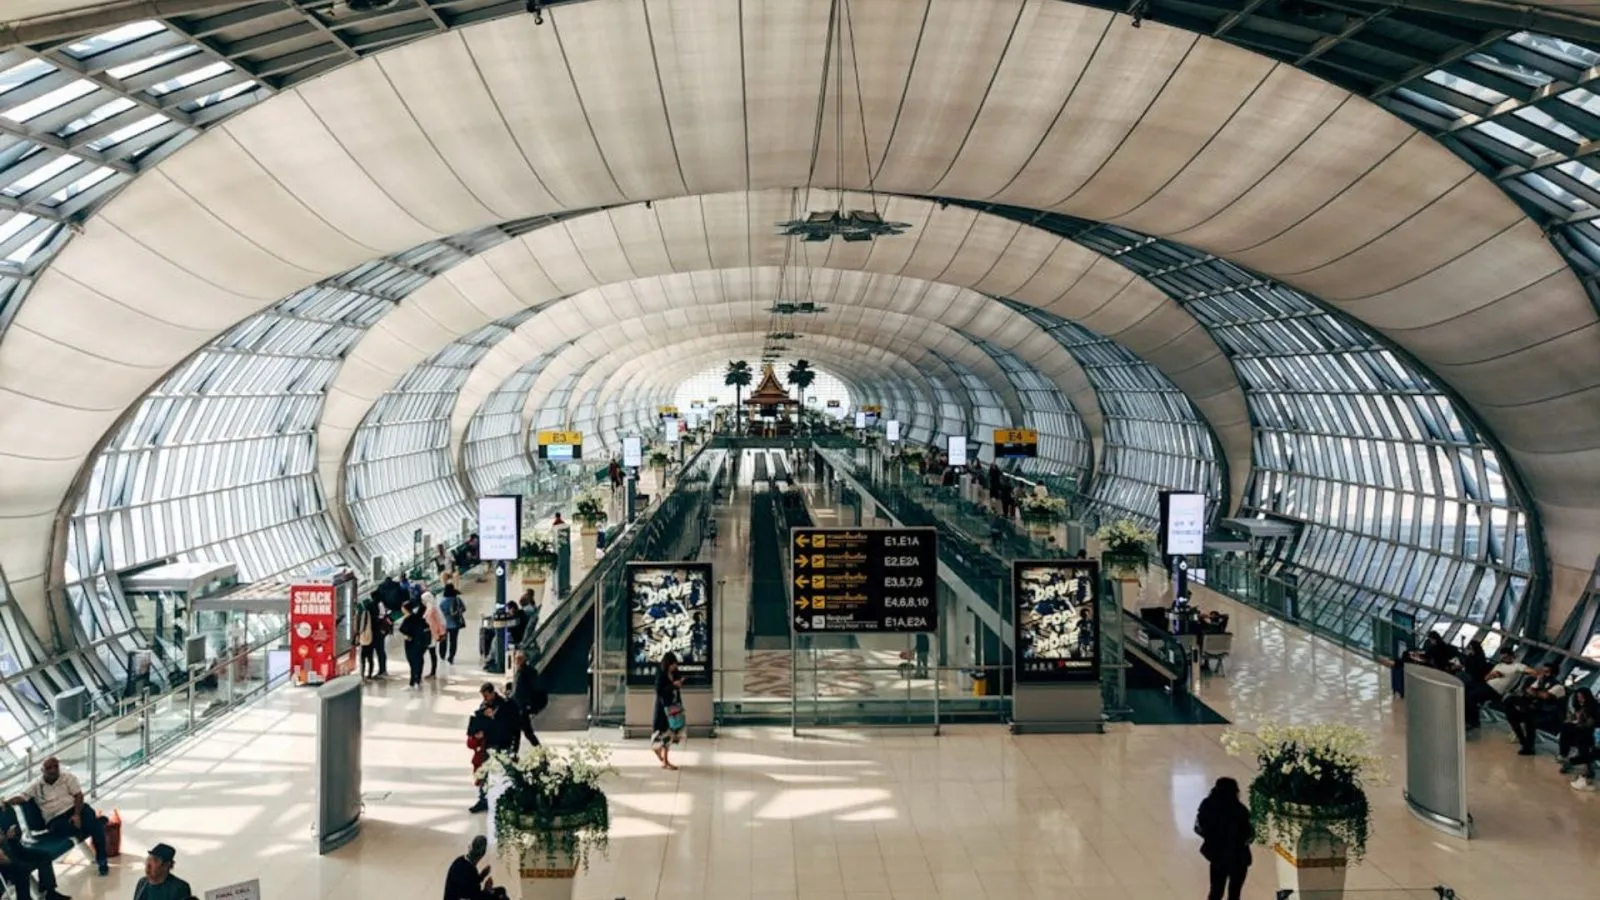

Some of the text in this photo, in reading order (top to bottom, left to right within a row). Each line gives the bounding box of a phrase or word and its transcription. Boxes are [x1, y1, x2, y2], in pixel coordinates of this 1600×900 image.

[552, 433, 567, 443] E3
[1008, 431, 1023, 441] E4
[884, 536, 920, 547] E1,E1A
[884, 556, 920, 567] E2,E2A
[884, 577, 924, 588] E3,5,7,9
[644, 580, 693, 606] DRIVE
[1031, 578, 1079, 602] DRIVE
[885, 616, 927, 627] E1A,E2A
[647, 632, 693, 658] MORE
[1036, 629, 1080, 652] MORE
